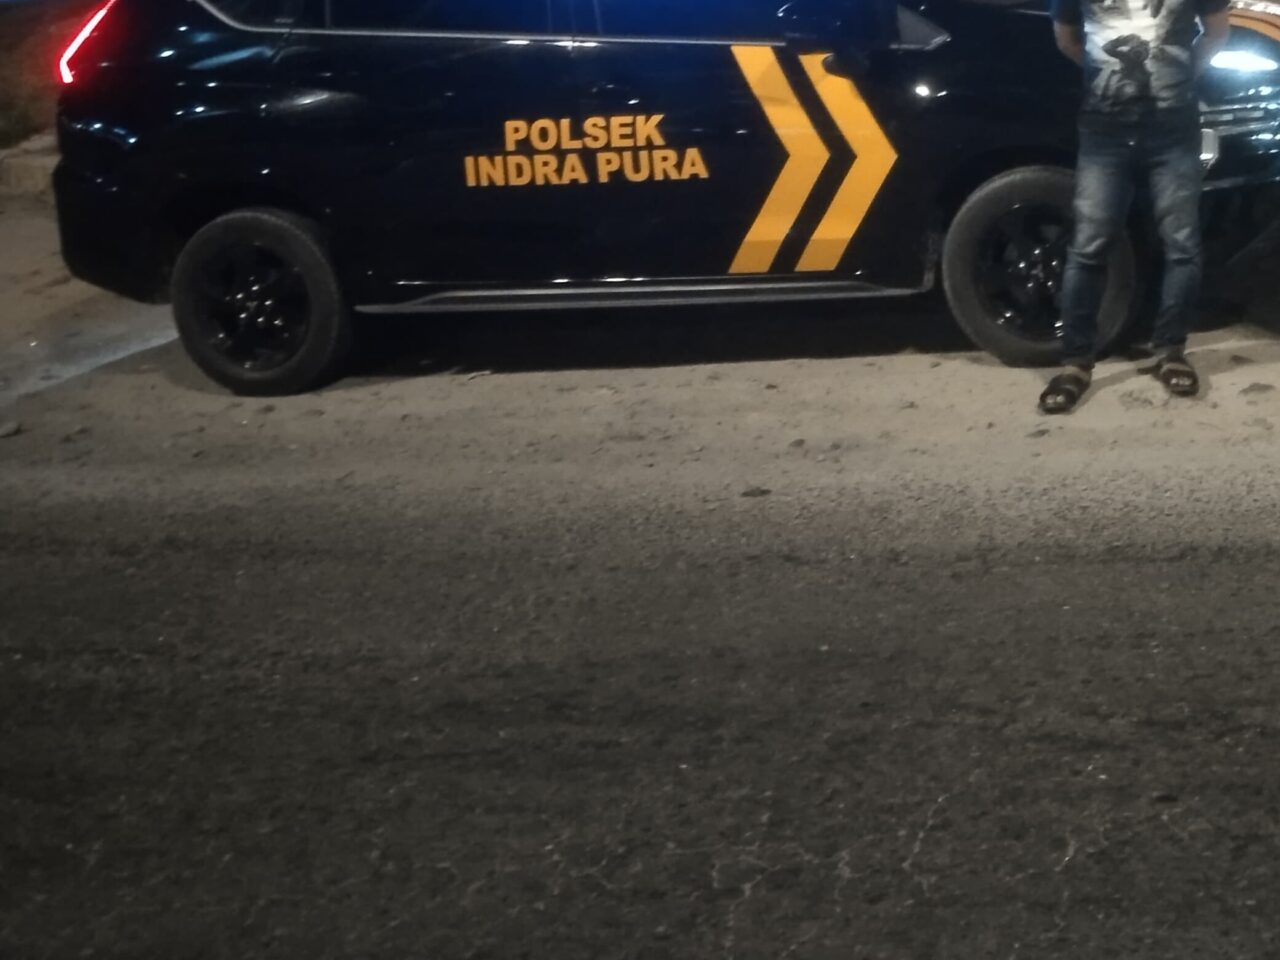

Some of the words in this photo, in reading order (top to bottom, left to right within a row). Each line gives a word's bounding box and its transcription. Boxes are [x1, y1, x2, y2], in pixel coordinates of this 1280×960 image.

[504, 114, 666, 152] POLSEK
[464, 152, 589, 187] INDRA
[596, 147, 709, 183] PURA
